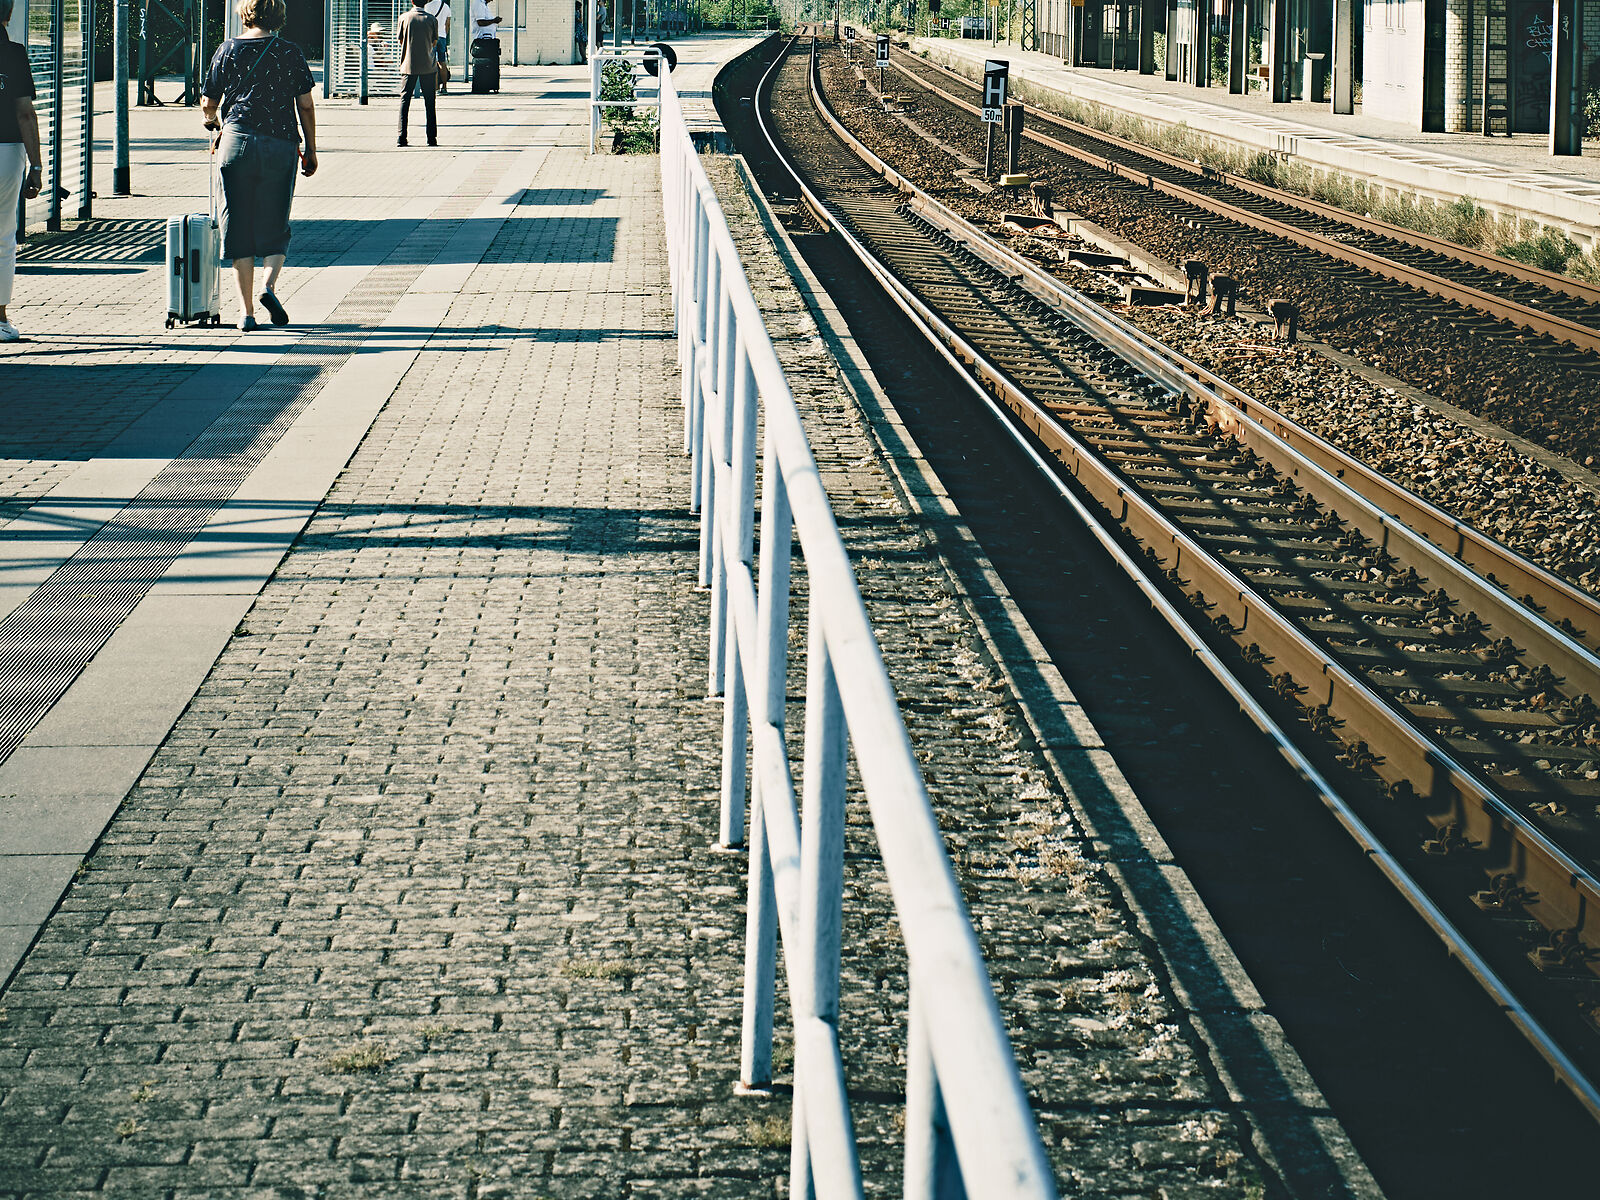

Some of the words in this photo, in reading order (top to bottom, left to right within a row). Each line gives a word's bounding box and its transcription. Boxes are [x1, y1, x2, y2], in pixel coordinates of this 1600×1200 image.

[941, 19, 949, 29] H
[848, 29, 855, 38] H
[877, 43, 888, 59] H
[985, 76, 1005, 106] H
[984, 109, 995, 121] 50
